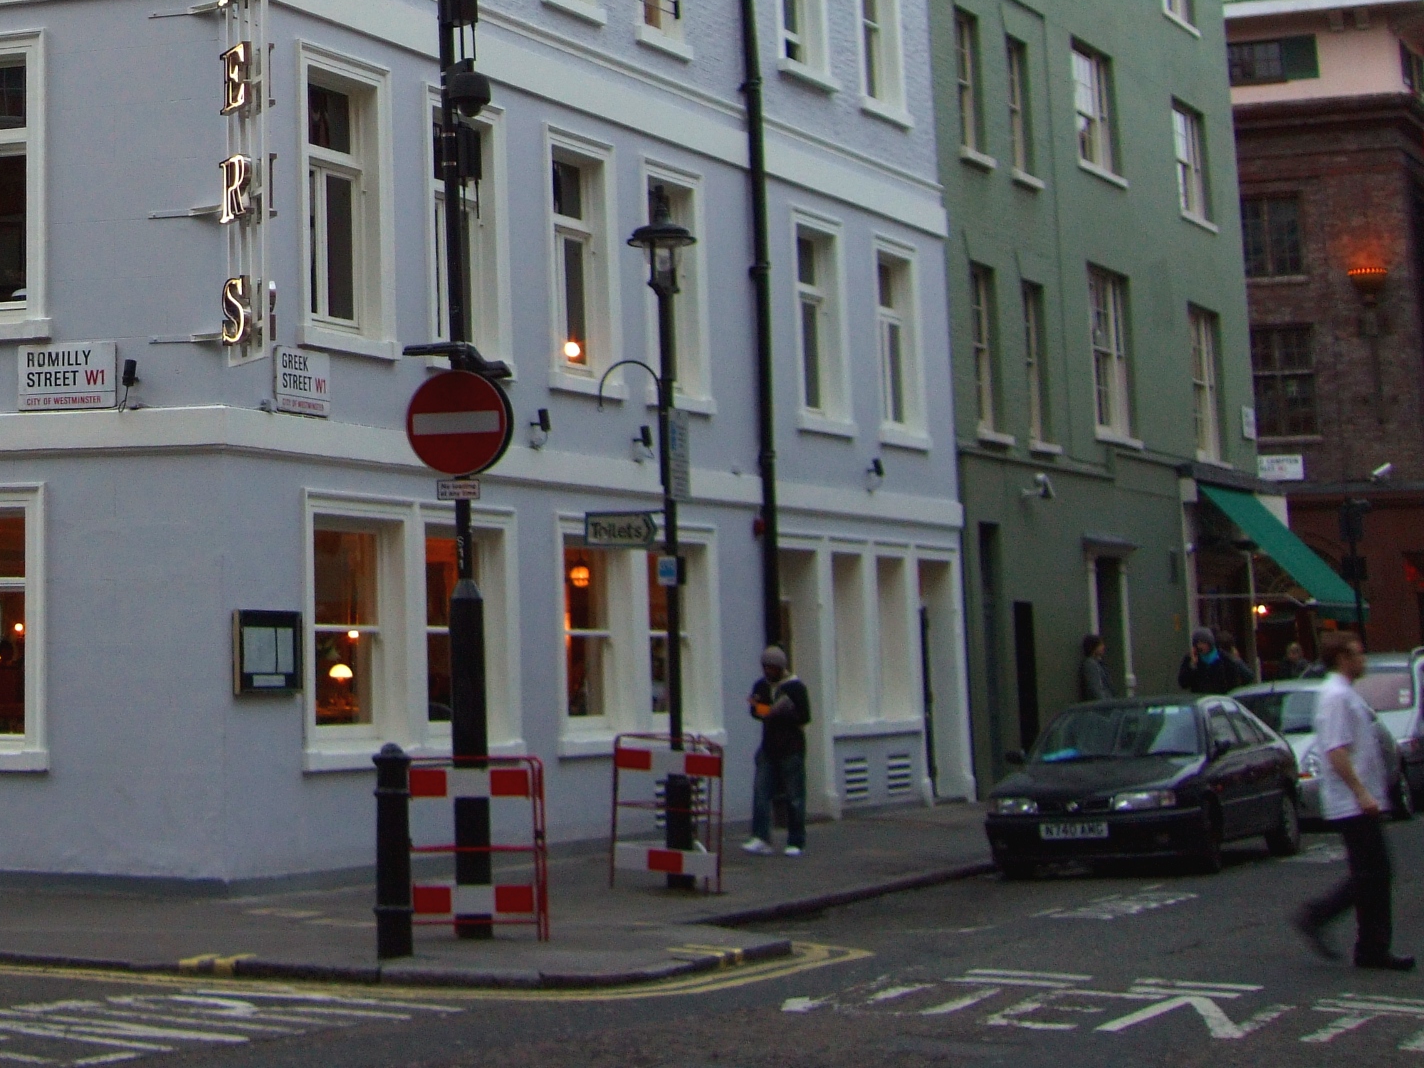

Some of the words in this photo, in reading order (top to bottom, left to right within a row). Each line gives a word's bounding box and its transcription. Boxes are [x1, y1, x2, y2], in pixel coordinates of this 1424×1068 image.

[26, 349, 92, 368] ROMILLY
[282, 352, 309, 372] GREEK
[26, 370, 79, 388] STREET
[84, 369, 105, 386] W1
[282, 372, 313, 392] STREET
[314, 377, 327, 394] W1
[26, 396, 41, 406] CITY
[43, 397, 52, 405] OF
[53, 395, 102, 405] WESTMINSTER
[590, 521, 643, 539] Toilets
